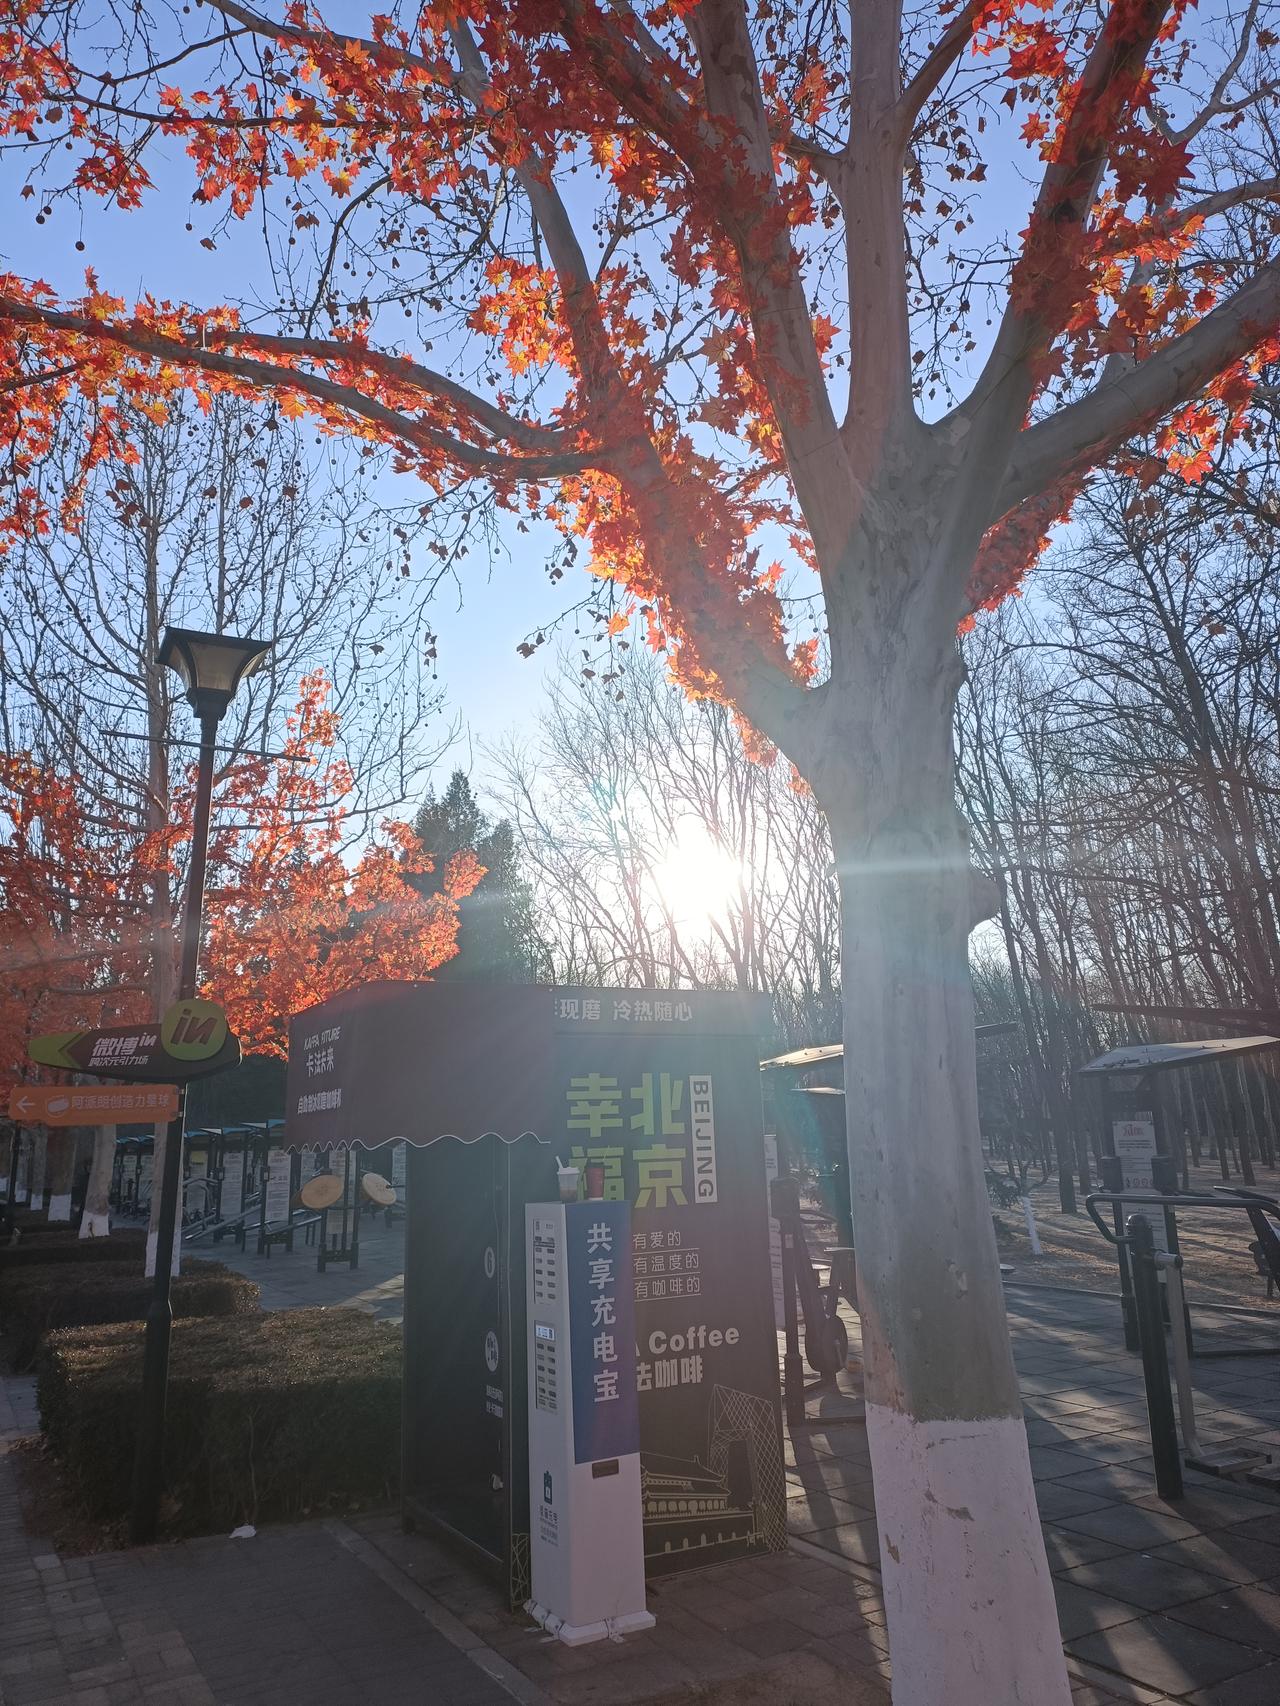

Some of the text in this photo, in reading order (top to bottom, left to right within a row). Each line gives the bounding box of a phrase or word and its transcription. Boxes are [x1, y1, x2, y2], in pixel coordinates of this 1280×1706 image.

[559, 999, 693, 1022] 现磨 冷热随心
[306, 1046, 334, 1078] 卡法未来
[692, 1080, 713, 1198] BEIJING
[632, 1230, 682, 1250] 有爱的
[633, 1253, 699, 1274] 有温度的
[634, 1276, 700, 1298] 有咖啡的
[586, 1222, 620, 1404] 共享充电宝
[648, 1325, 741, 1355] Coffee
